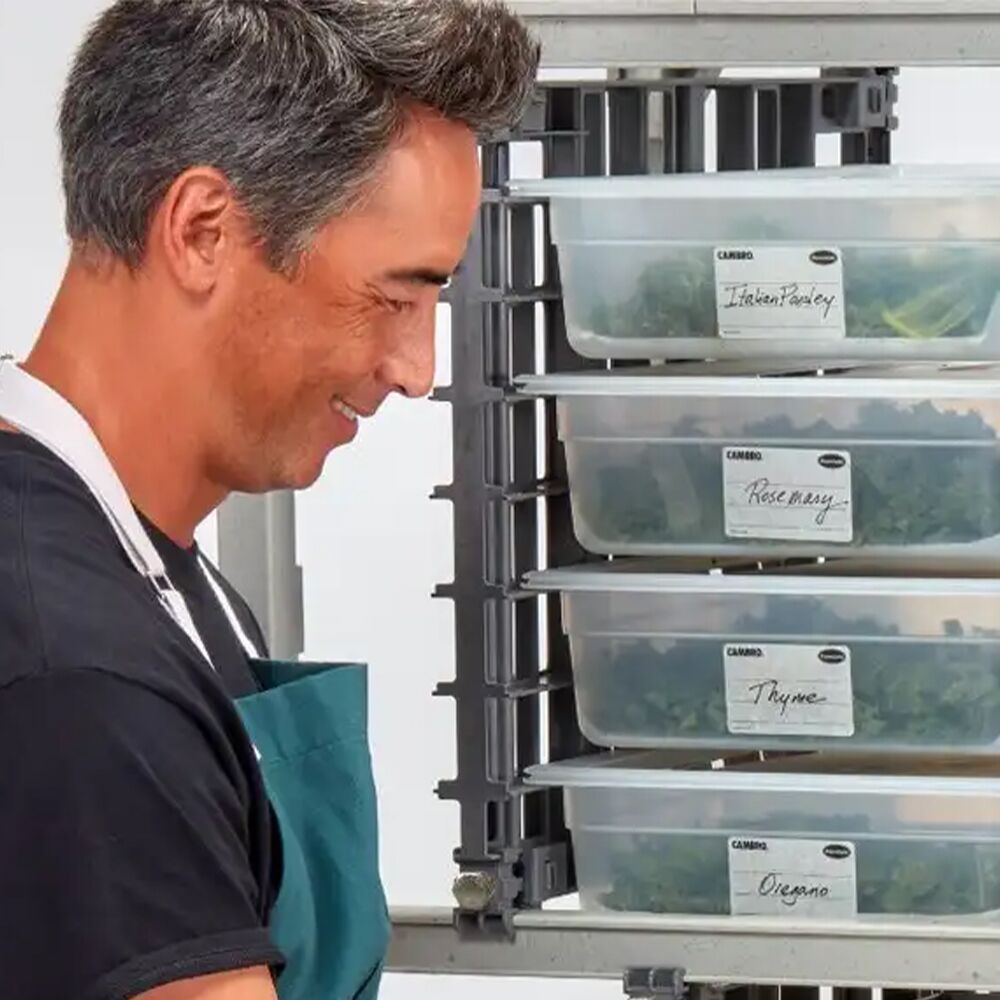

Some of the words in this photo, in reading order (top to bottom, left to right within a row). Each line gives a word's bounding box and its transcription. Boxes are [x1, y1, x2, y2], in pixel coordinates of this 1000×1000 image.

[723, 283, 780, 309] Italian
[744, 477, 849, 525] Rosemary
[749, 679, 828, 717] Thyme
[759, 872, 829, 906] Oregano
